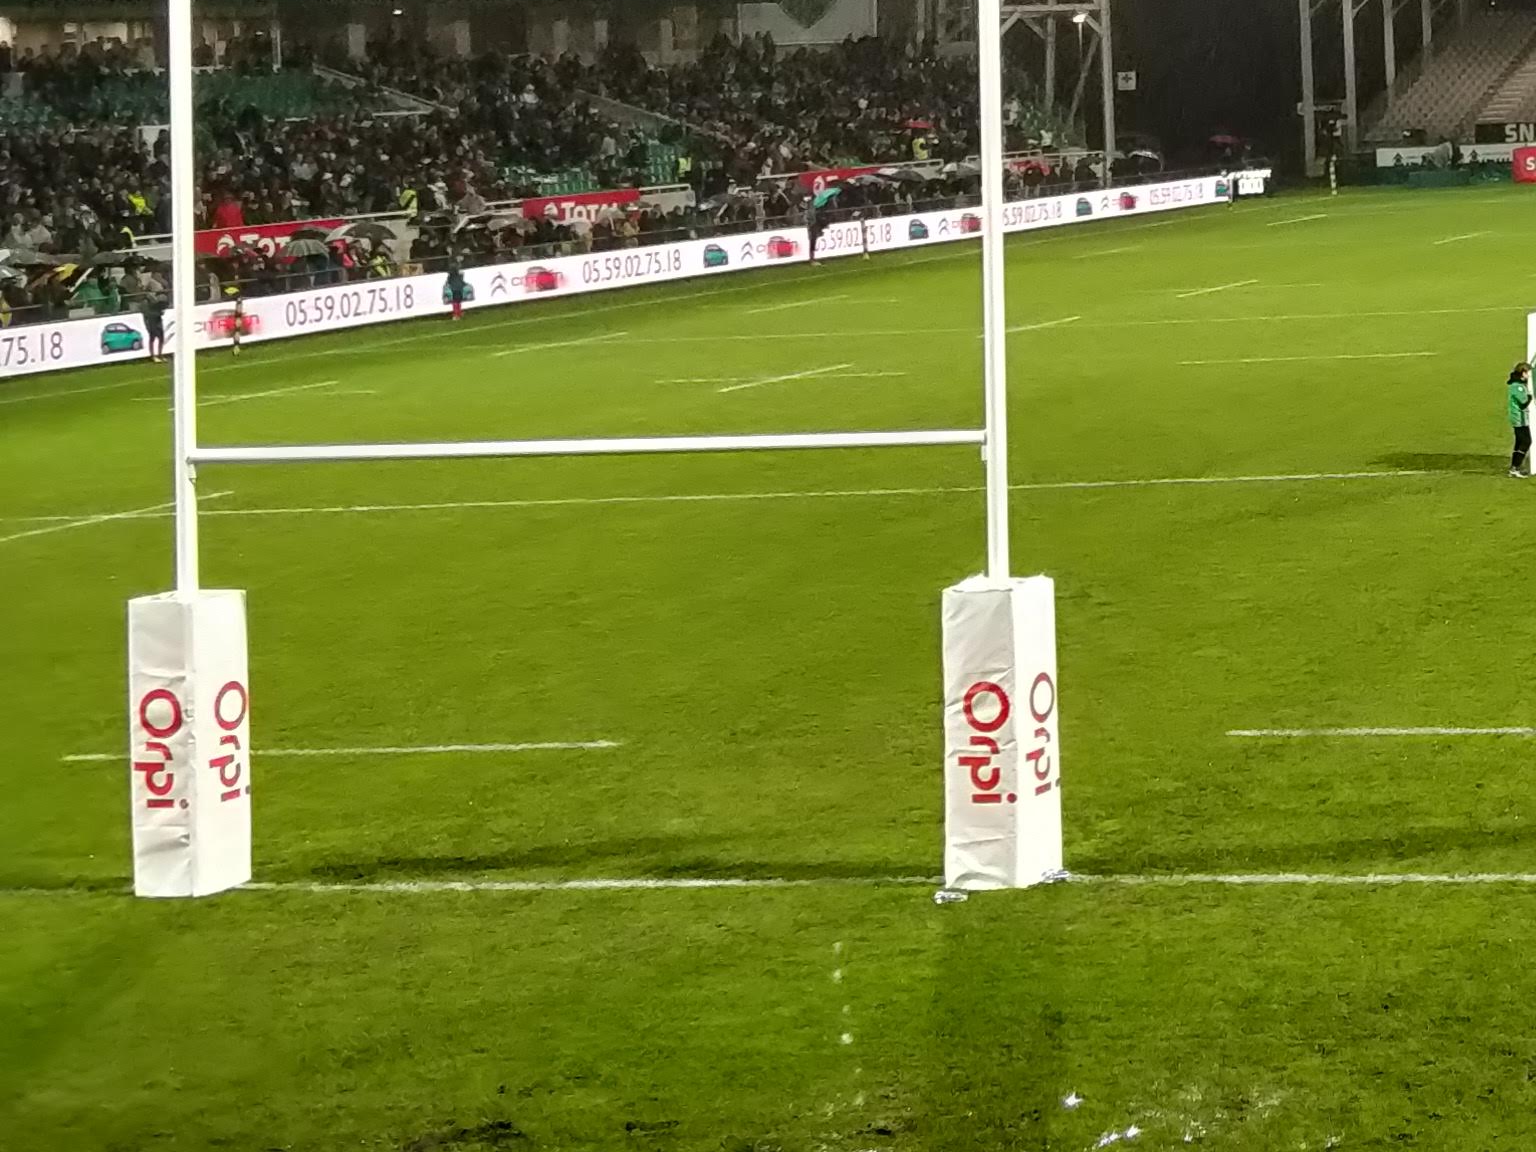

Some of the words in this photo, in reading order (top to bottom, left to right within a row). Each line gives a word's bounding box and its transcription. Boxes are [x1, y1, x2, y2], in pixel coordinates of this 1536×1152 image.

[285, 284, 414, 327] 05.59.02.75.18
[582, 248, 682, 284] 05.59.02.75.18
[134, 688, 189, 808] Orpi
[209, 681, 251, 802] Orpi
[958, 681, 1018, 804] Orpi
[1026, 672, 1061, 796] Orpi
